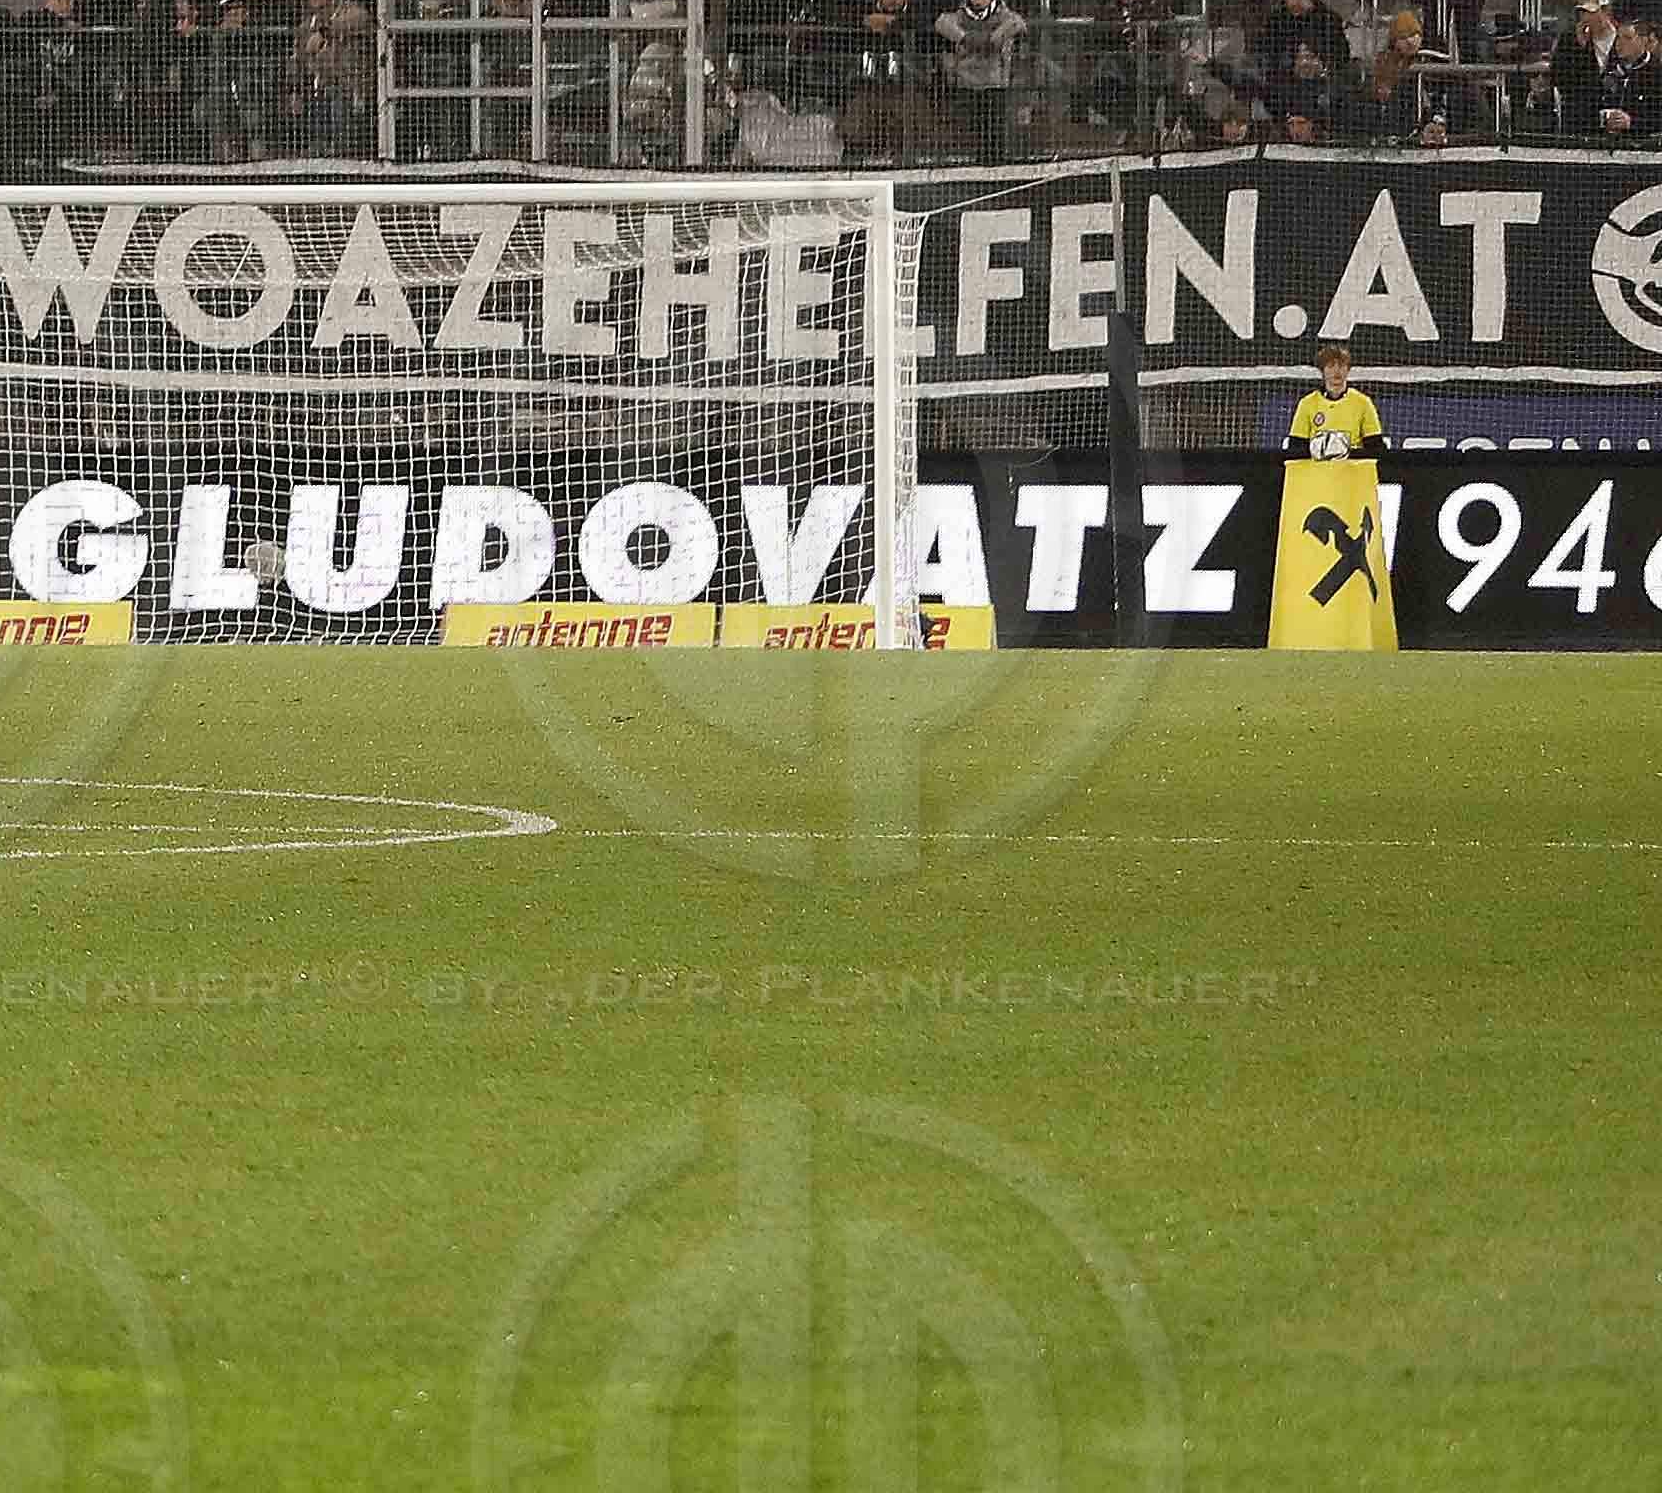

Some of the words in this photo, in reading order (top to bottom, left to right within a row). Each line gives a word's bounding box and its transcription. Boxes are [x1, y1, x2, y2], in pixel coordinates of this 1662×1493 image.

[9, 479, 1244, 613] GLUDOVATZ
[1377, 478, 1662, 614] 194
[486, 612, 673, 649] antenne
